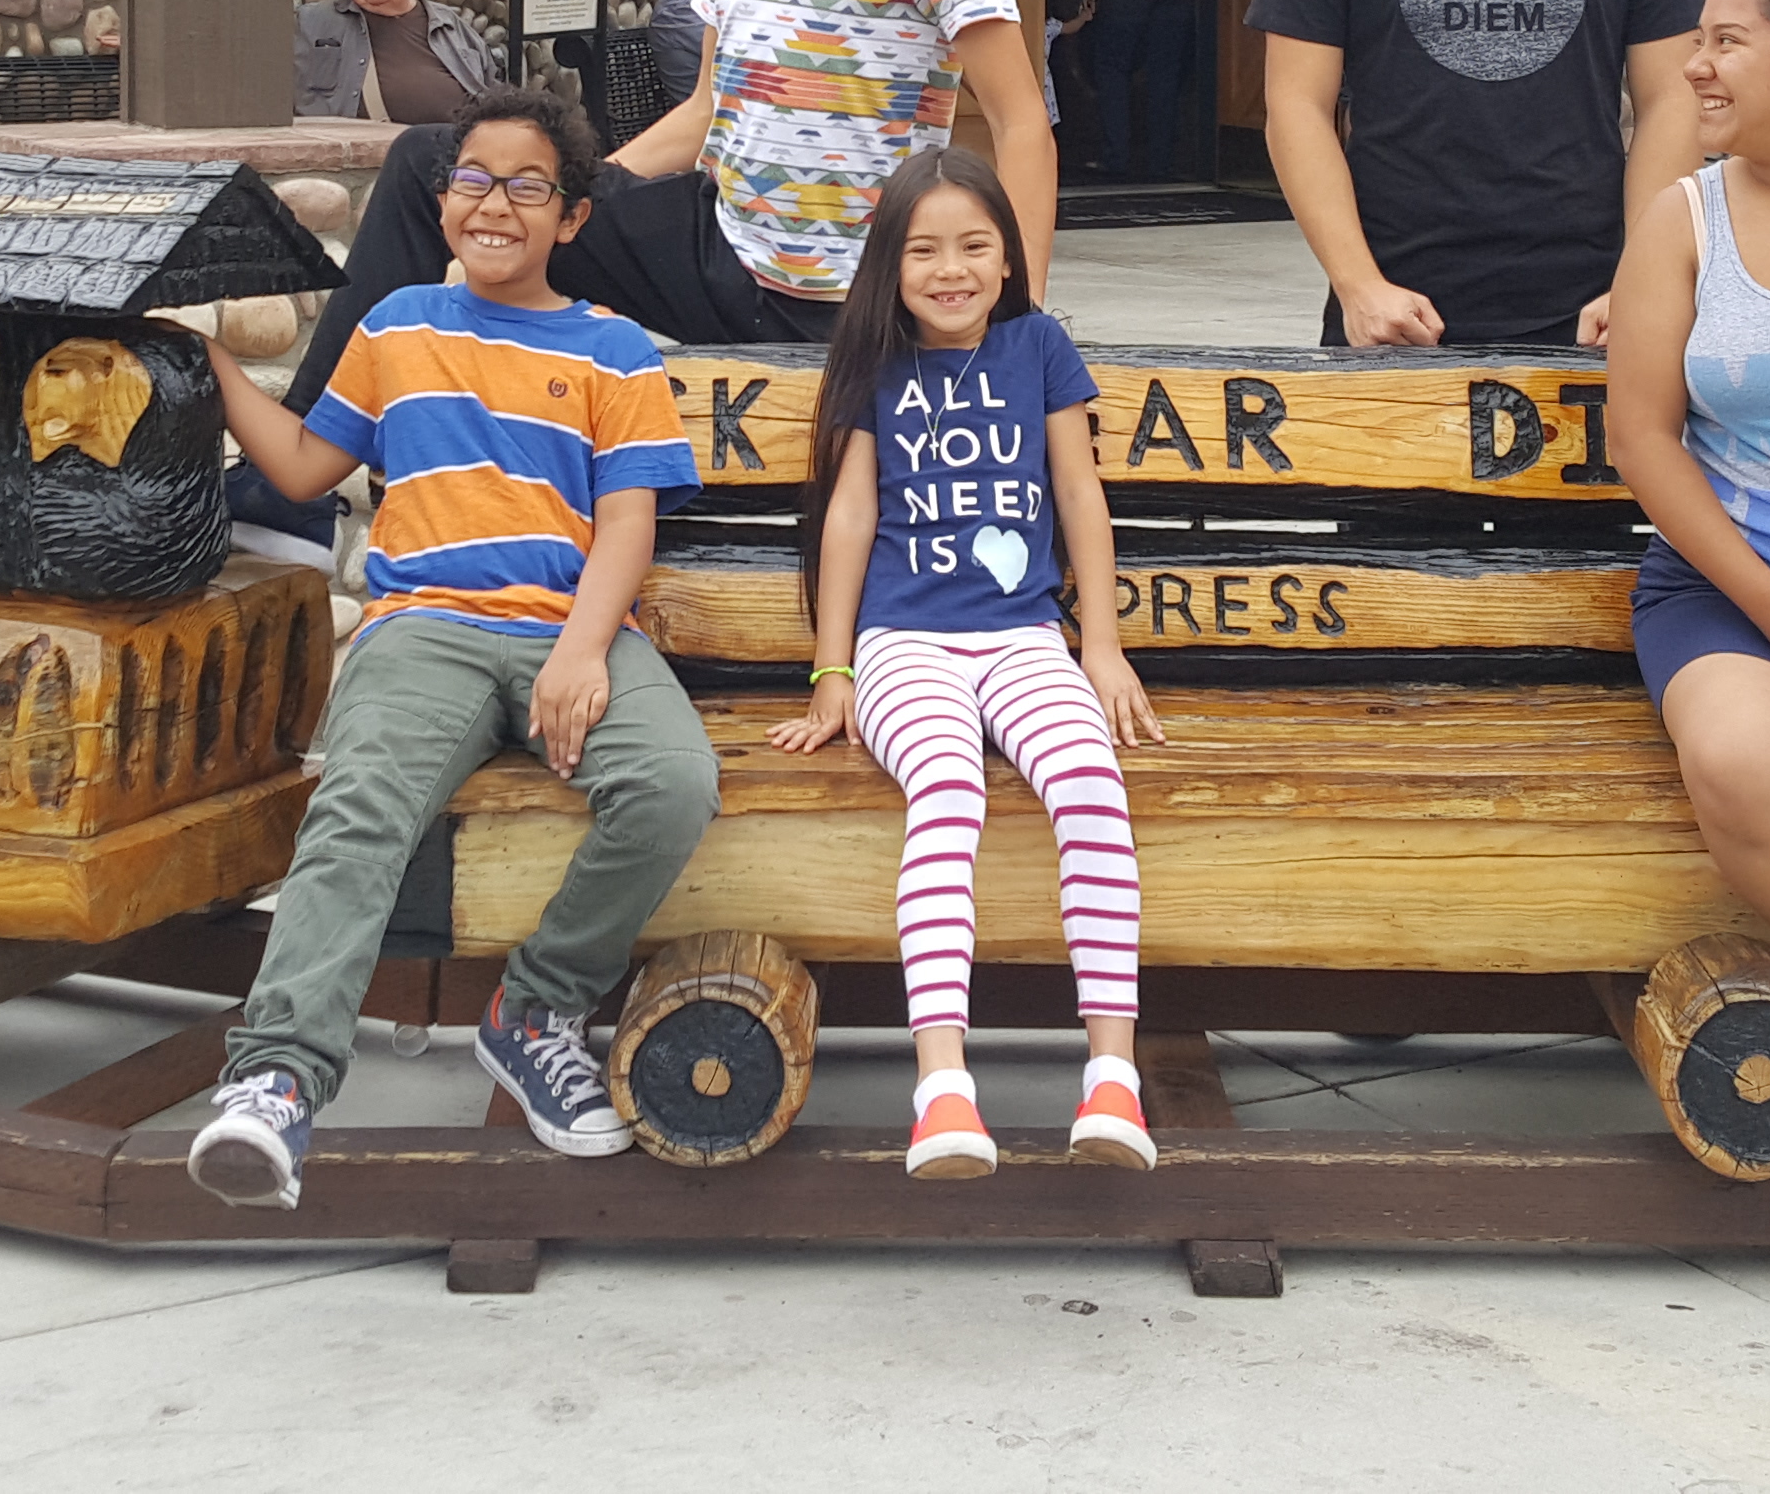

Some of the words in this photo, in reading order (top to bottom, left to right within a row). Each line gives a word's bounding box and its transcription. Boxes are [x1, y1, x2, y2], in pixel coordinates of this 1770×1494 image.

[1443, 2, 1544, 32] DIEM
[894, 371, 1006, 415] ALL
[894, 424, 1021, 472] YOU
[904, 480, 1042, 524] NEED
[909, 535, 957, 574] IS
